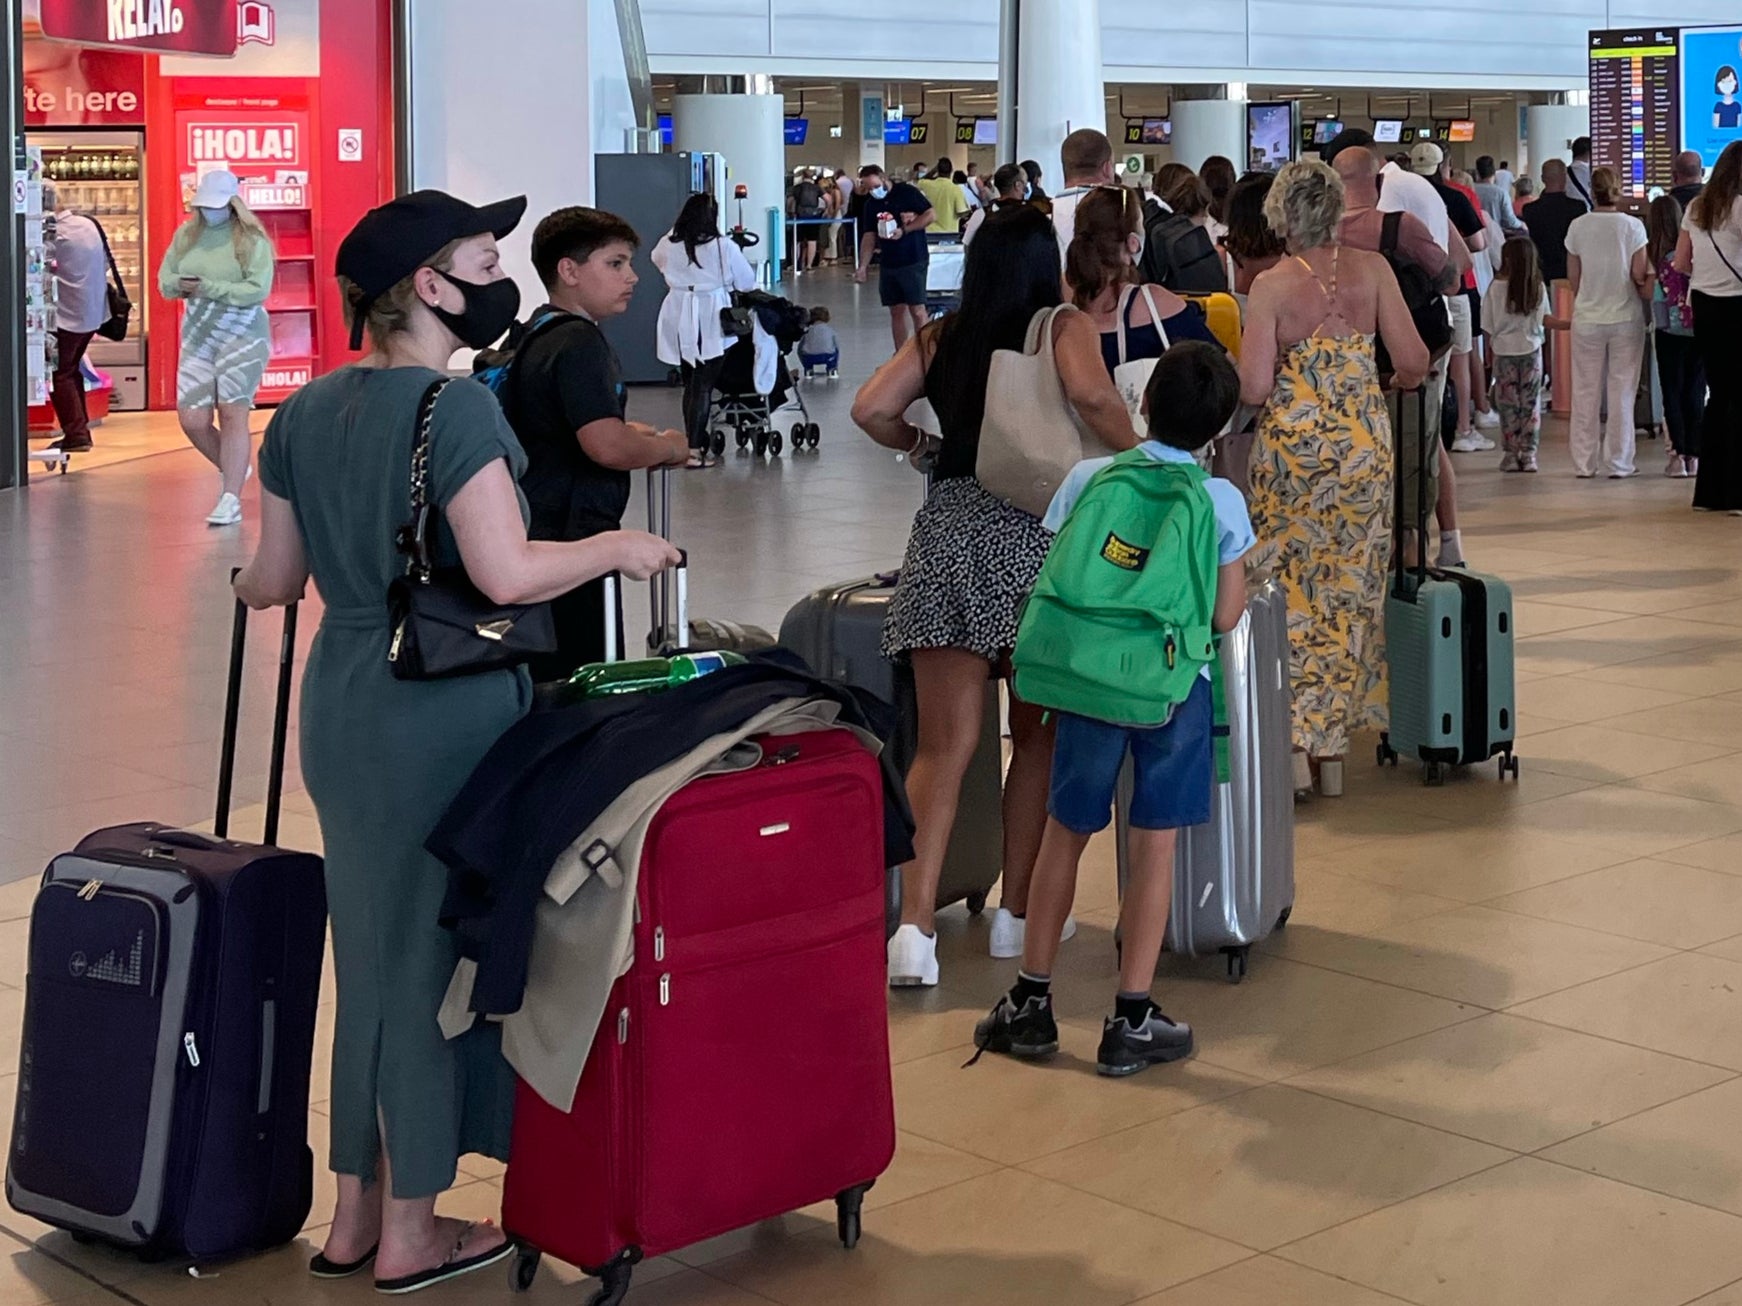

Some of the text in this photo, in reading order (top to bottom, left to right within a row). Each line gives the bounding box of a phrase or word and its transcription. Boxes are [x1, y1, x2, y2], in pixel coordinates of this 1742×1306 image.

[65, 86, 137, 112] here
[911, 126, 926, 140] 07
[957, 126, 973, 140] 08
[1128, 128, 1140, 141] 10
[193, 127, 293, 159] ¡HOLA!
[248, 187, 302, 205] HELLO!
